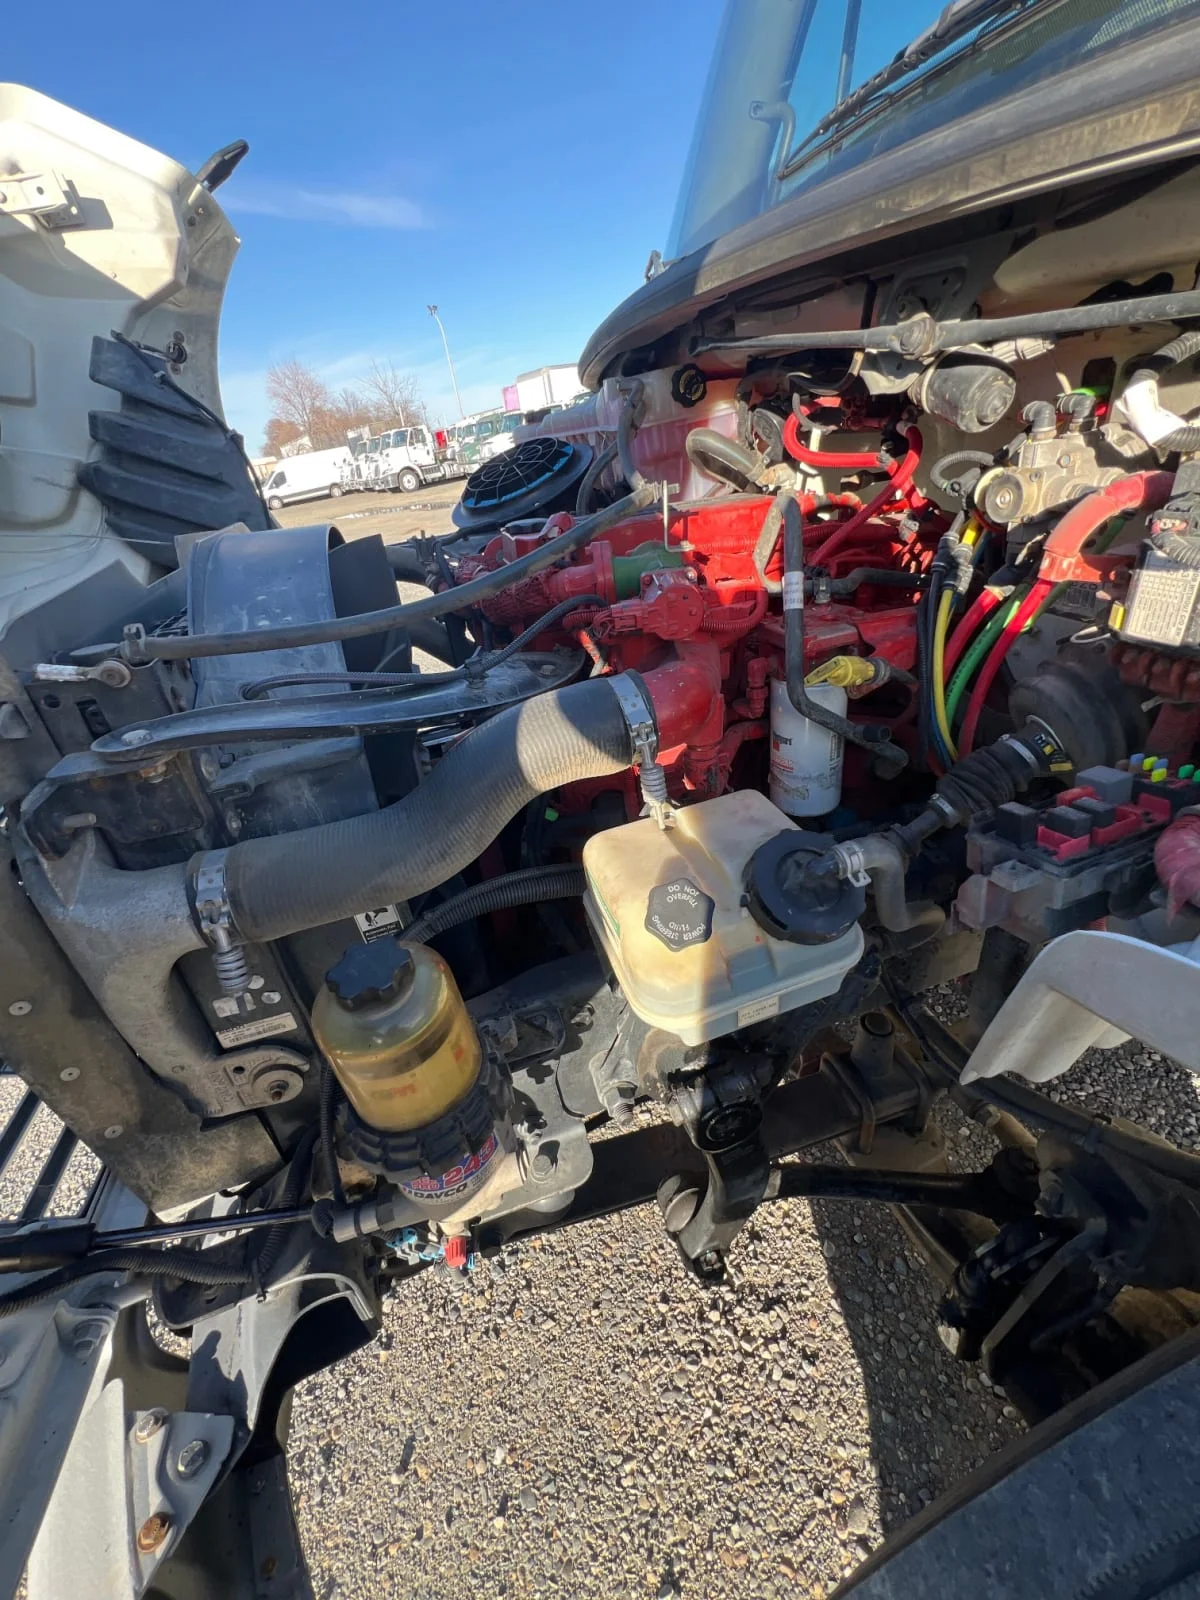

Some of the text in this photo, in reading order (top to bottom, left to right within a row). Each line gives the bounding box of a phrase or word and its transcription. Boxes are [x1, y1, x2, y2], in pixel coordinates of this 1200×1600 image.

[667, 884, 680, 893] DO
[666, 892, 698, 908] OVERFILL
[651, 914, 706, 941] POWER STEERING
[668, 921, 690, 932] FLUID
[443, 1134, 496, 1188] 243
[413, 1182, 468, 1199] DAVCO
